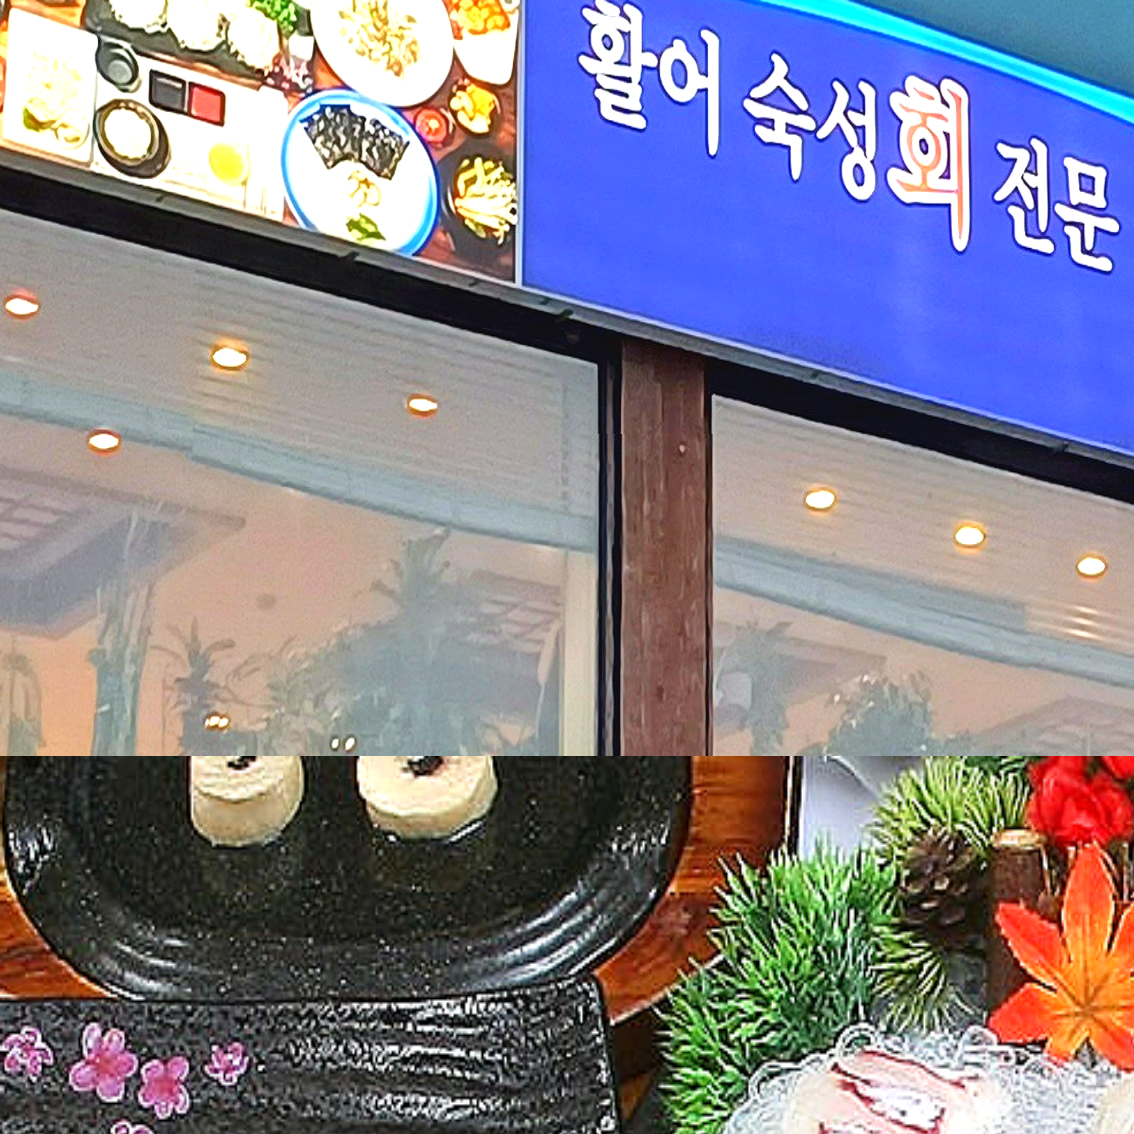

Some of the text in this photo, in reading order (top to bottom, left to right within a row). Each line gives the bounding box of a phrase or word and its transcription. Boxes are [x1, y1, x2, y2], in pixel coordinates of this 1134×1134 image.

[577, 0, 1120, 271] 활어 숙성회 전문
